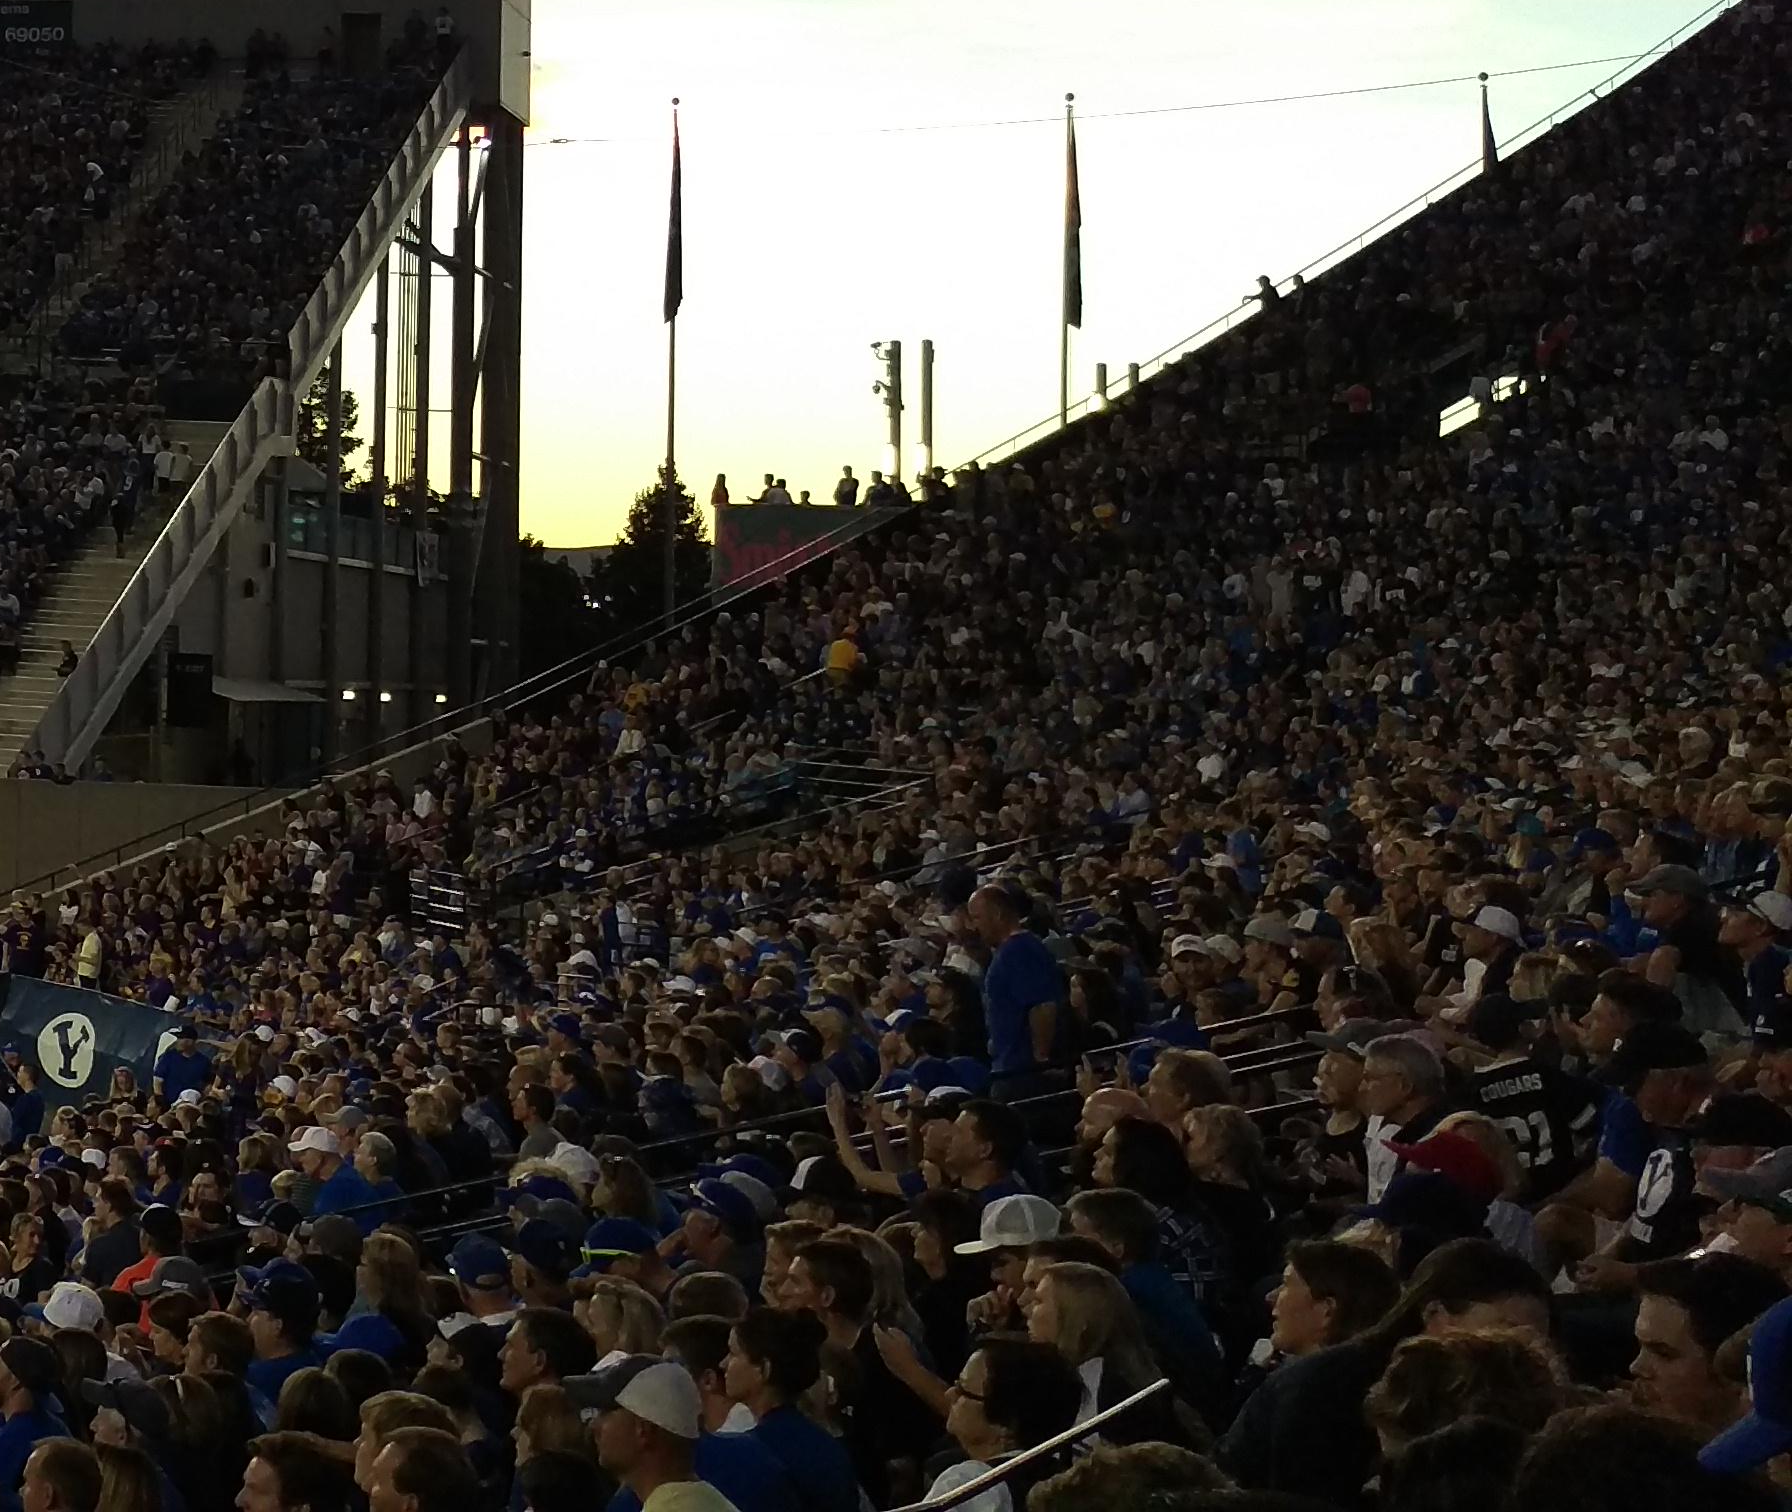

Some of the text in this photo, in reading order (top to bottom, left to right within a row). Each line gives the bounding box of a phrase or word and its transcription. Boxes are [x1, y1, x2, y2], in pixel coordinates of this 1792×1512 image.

[4, 27, 65, 43] 69050
[52, 1020, 90, 1080] Y
[1480, 1073, 1543, 1103] COUGARS
